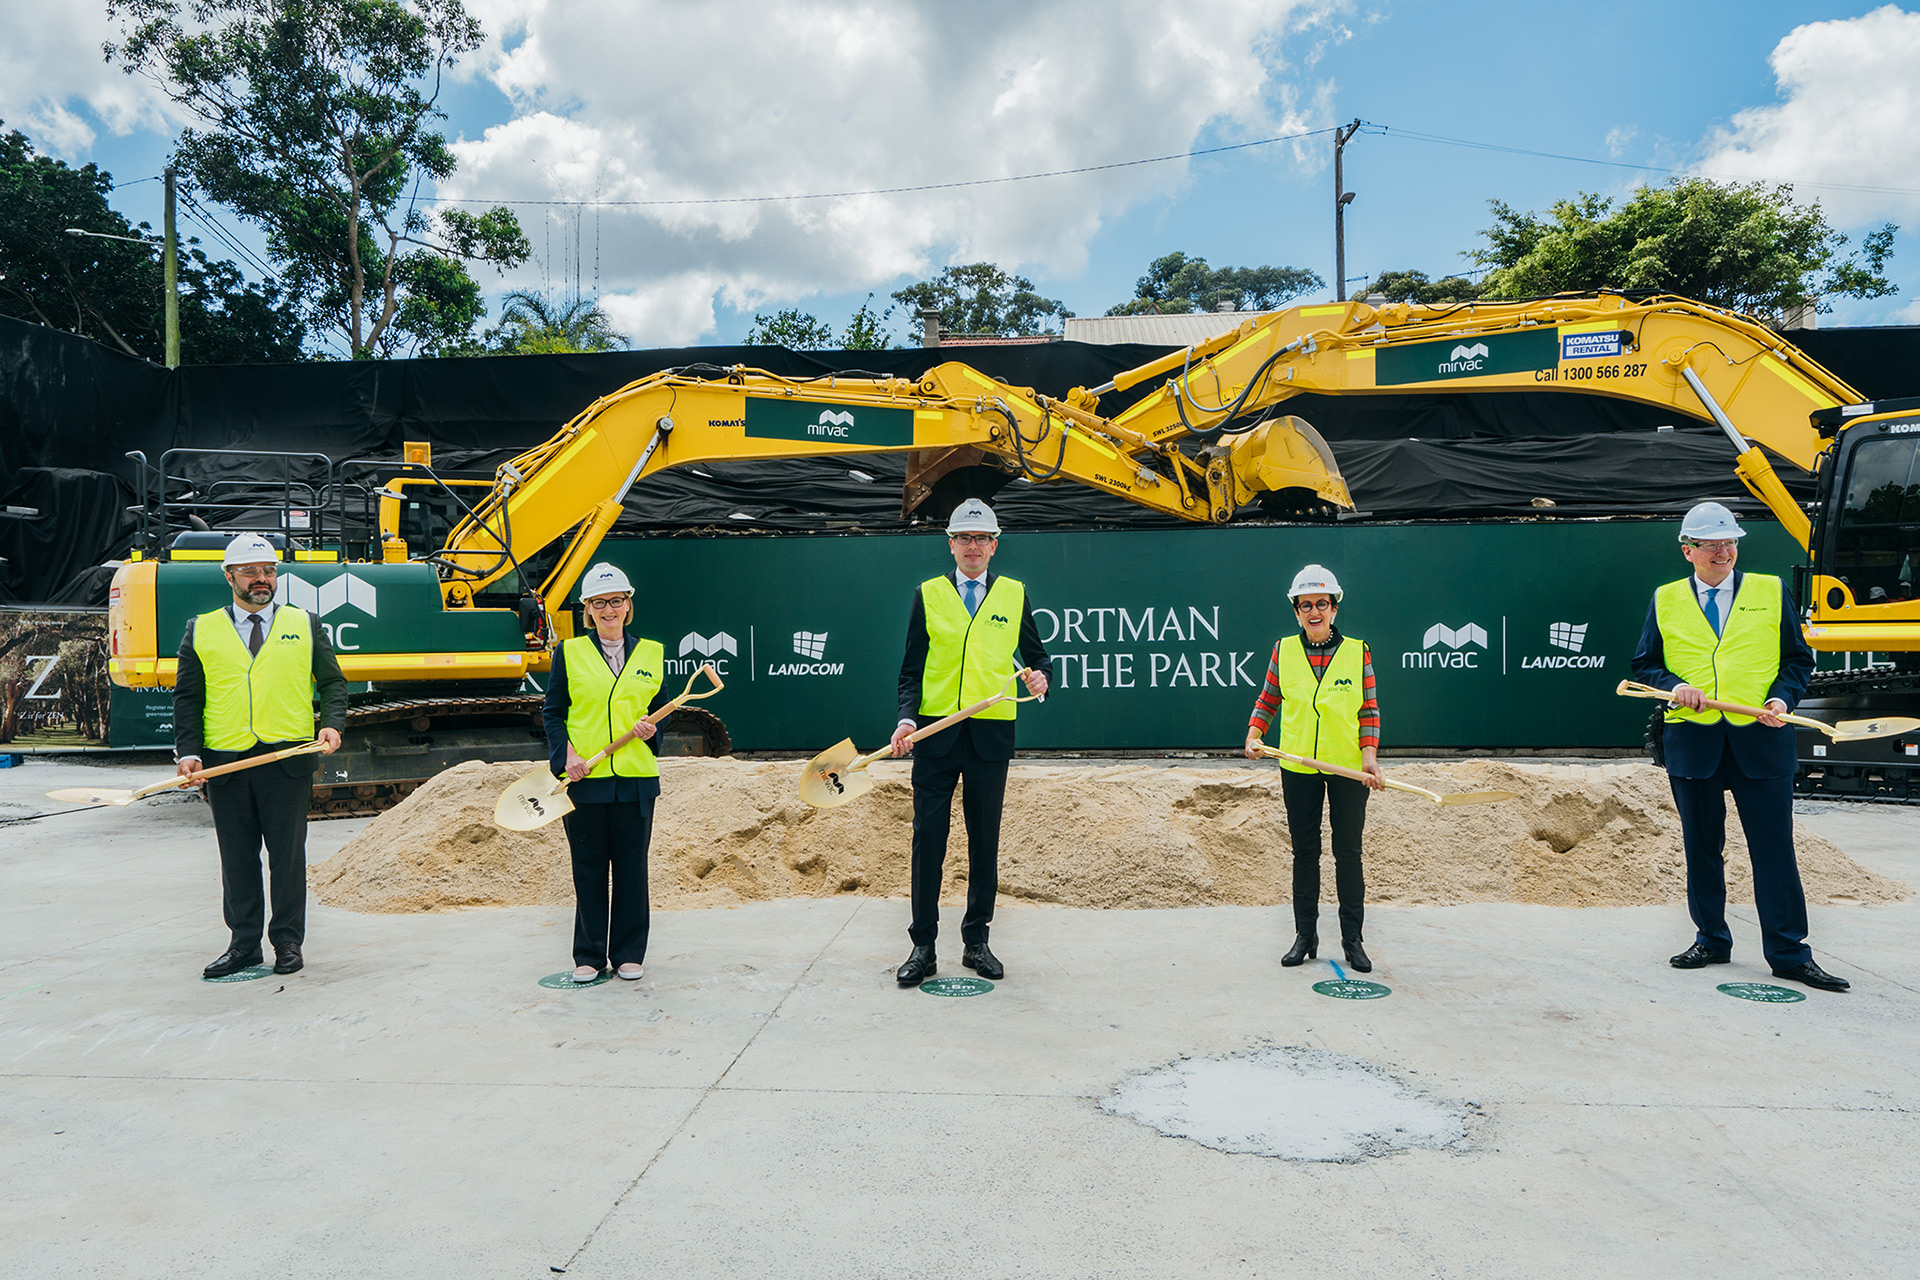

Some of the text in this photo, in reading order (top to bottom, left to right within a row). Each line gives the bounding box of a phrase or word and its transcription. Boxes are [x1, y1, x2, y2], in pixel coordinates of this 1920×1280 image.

[1566, 334, 1619, 346] KOMATSU
[1573, 344, 1612, 355] RENTAL
[1438, 359, 1483, 374] mirvac
[1535, 364, 1648, 382] Call 1300 566 287
[807, 424, 849, 437] mirvac
[1152, 428, 1166, 437] SWL
[1094, 473, 1108, 484] SWL
[984, 619, 1006, 631] mirvac
[1402, 651, 1478, 669] mirvac
[1521, 655, 1606, 669] LANDCOM
[768, 663, 845, 676] LANDCOM
[1050, 651, 1257, 689] THE PARK
[24, 655, 61, 699] Z
[35, 711, 46, 721] for
[47, 711, 64, 719] ZEN
[819, 768, 837, 796] mirvac
[517, 793, 536, 818] mirvac
